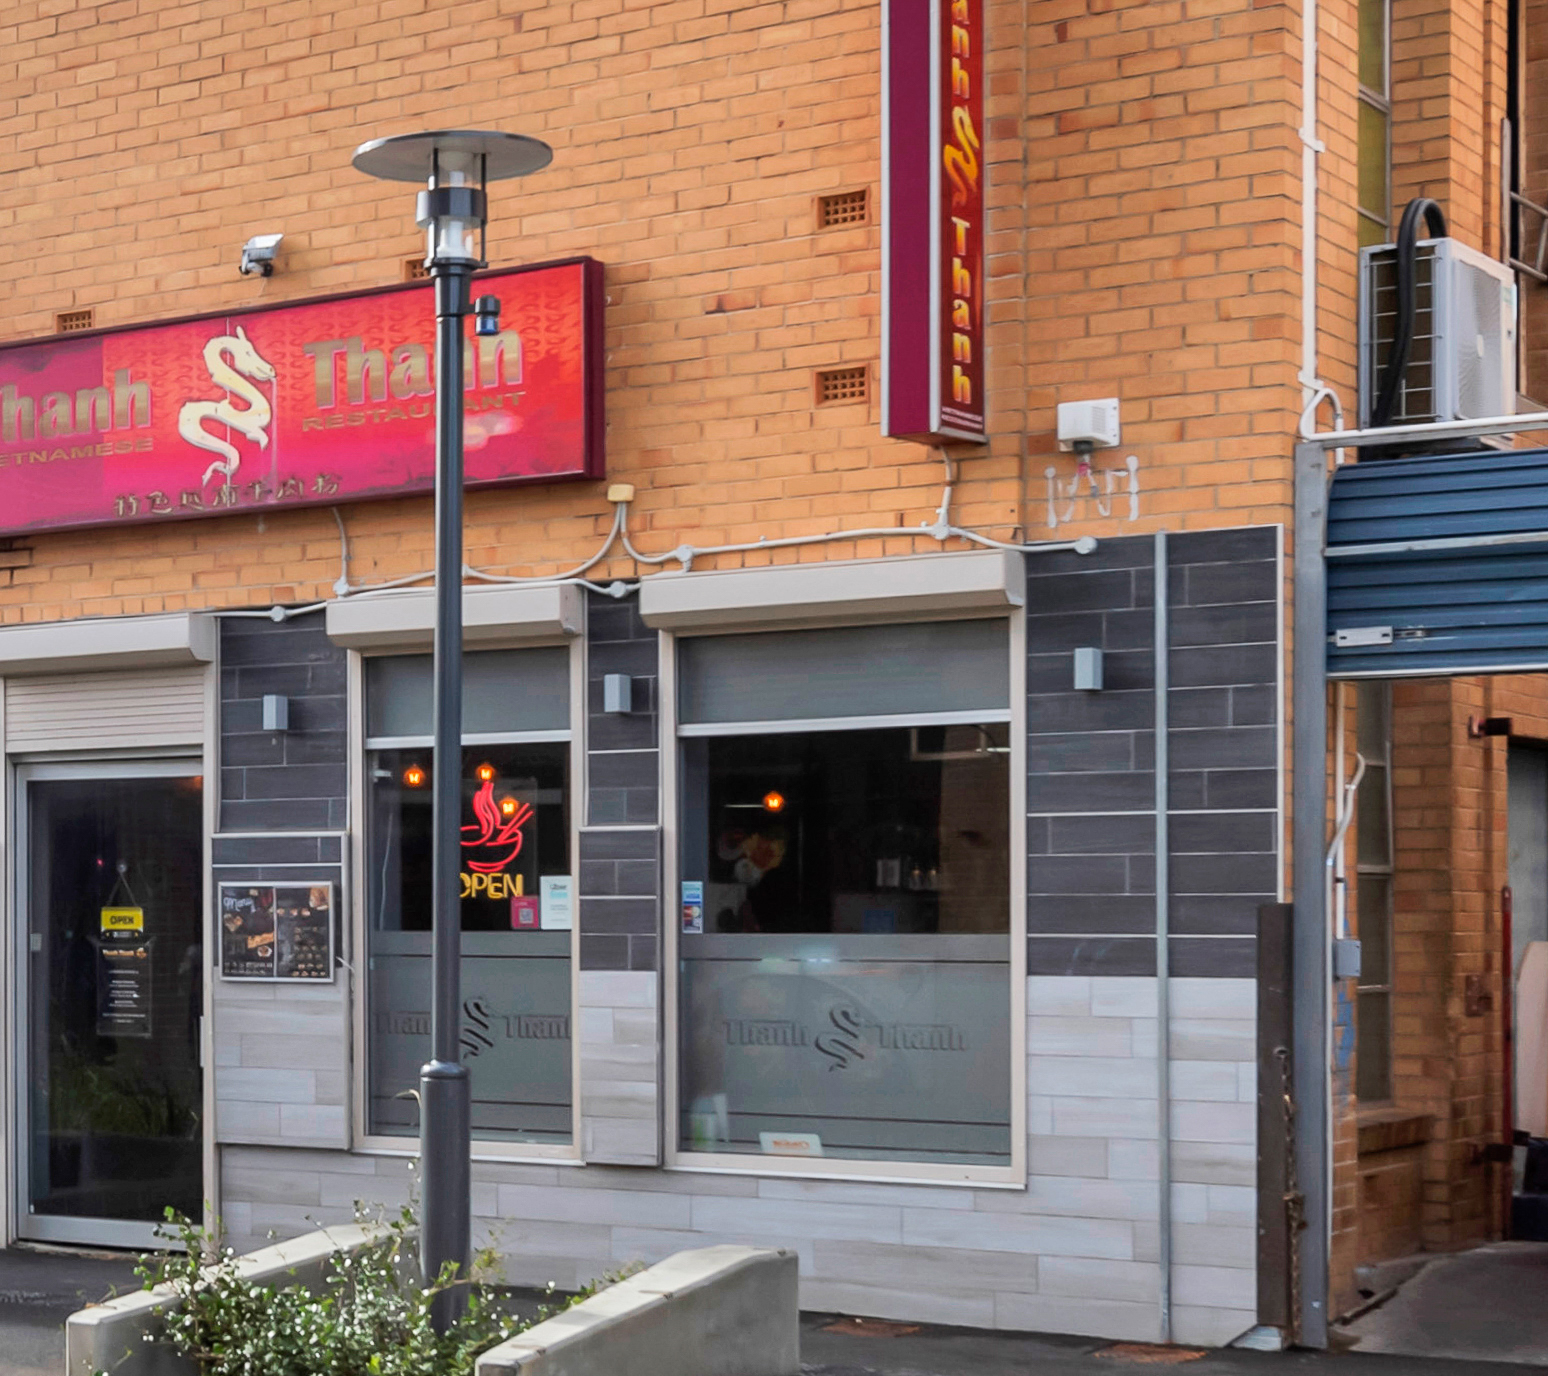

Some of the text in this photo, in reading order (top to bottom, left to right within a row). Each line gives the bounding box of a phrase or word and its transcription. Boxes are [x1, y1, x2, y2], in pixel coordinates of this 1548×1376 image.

[951, 215, 971, 404] Thanh
[302, 391, 526, 433] RESTAUANT
[110, 915, 135, 925] OPEN
[722, 1018, 809, 1047] Thanh
